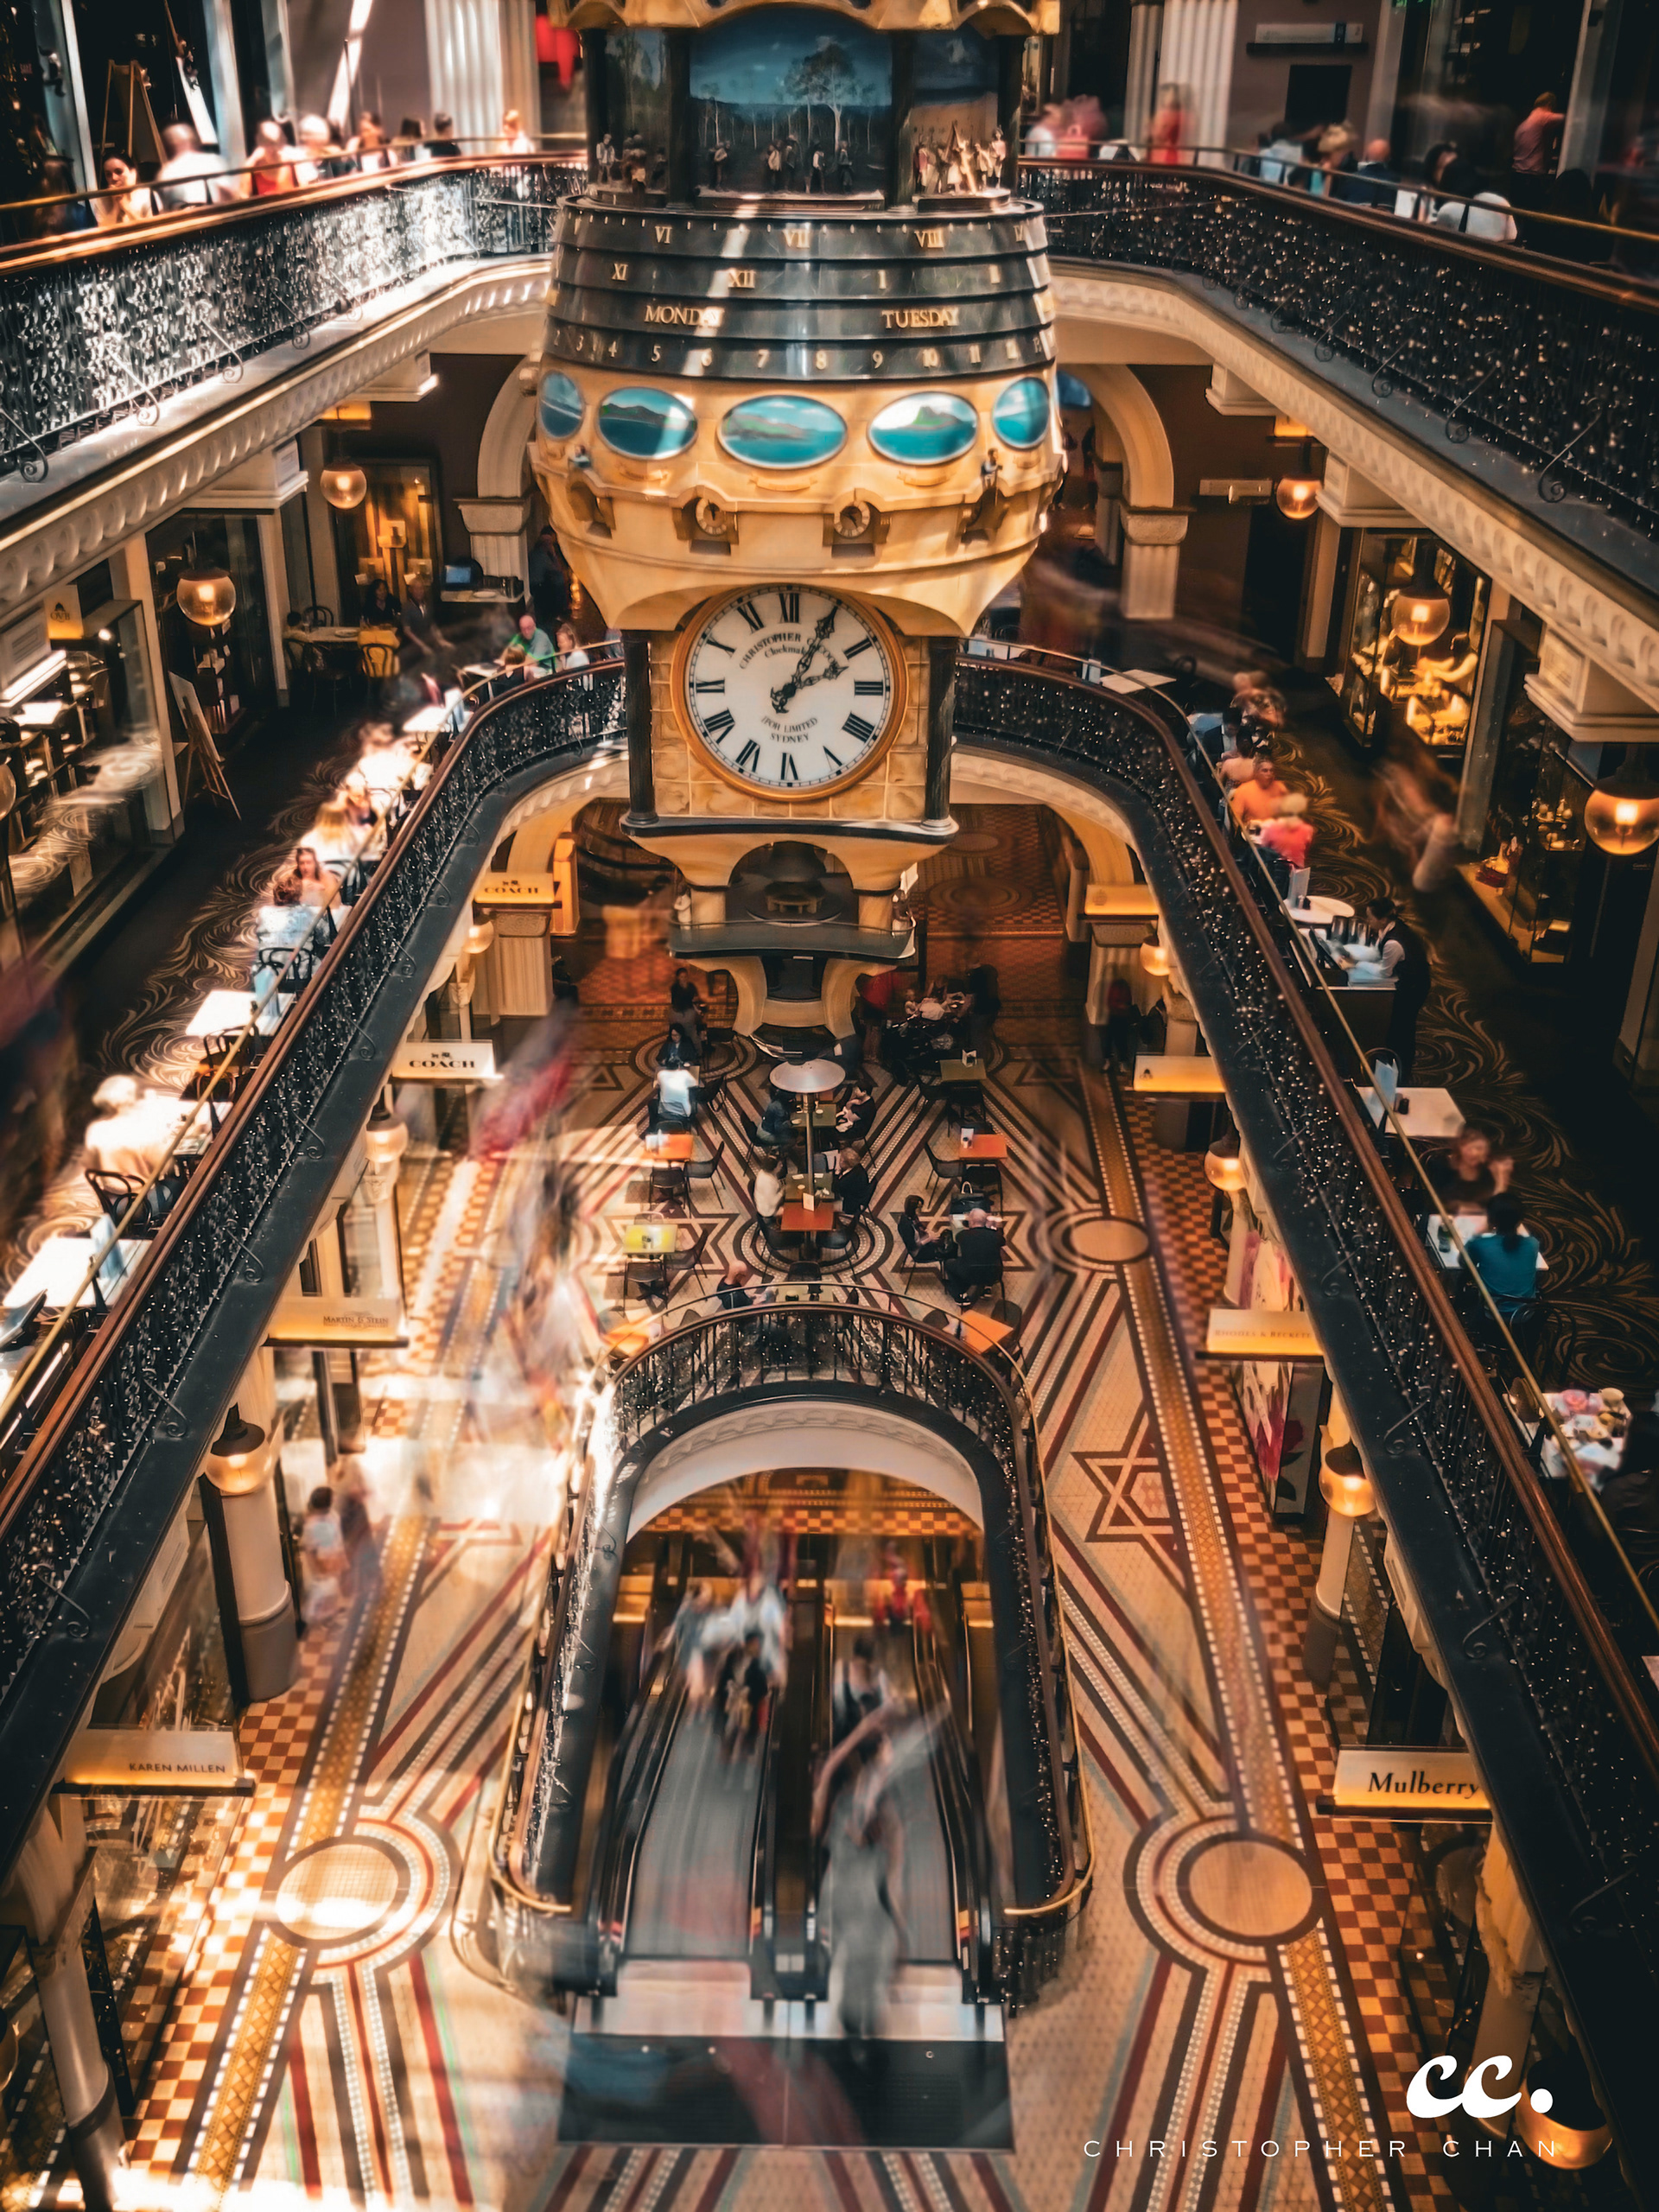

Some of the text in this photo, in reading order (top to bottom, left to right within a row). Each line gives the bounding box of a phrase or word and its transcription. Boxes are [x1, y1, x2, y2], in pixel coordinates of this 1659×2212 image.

[655, 226, 672, 245] VI
[784, 228, 811, 249] VII
[612, 263, 629, 282] XI
[728, 270, 755, 289] XII
[645, 305, 961, 329] MONDAY TUESDAY
[575, 334, 585, 352] 3
[608, 340, 618, 359] 4
[651, 345, 661, 363] 5
[702, 348, 713, 367] 6
[758, 348, 771, 369] 7
[816, 350, 827, 370] 8
[873, 350, 883, 370] 9
[922, 346, 939, 368] 10
[736, 601, 765, 634] XI
[779, 593, 800, 624] XII
[706, 634, 736, 658] X
[740, 632, 801, 670] CHRISTOPHER
[842, 638, 873, 659] II
[695, 677, 725, 694] IX
[854, 678, 884, 696] III
[703, 707, 735, 744] VIII
[771, 732, 810, 744] SYDNEY
[784, 717, 818, 734] LIMITED
[841, 711, 876, 744] IIII
[735, 739, 760, 773] VII
[780, 752, 799, 781] VI
[823, 745, 843, 772] V
[129, 1763, 226, 1773] KAREN MILLEN
[1368, 1770, 1479, 1800] Mulberry
